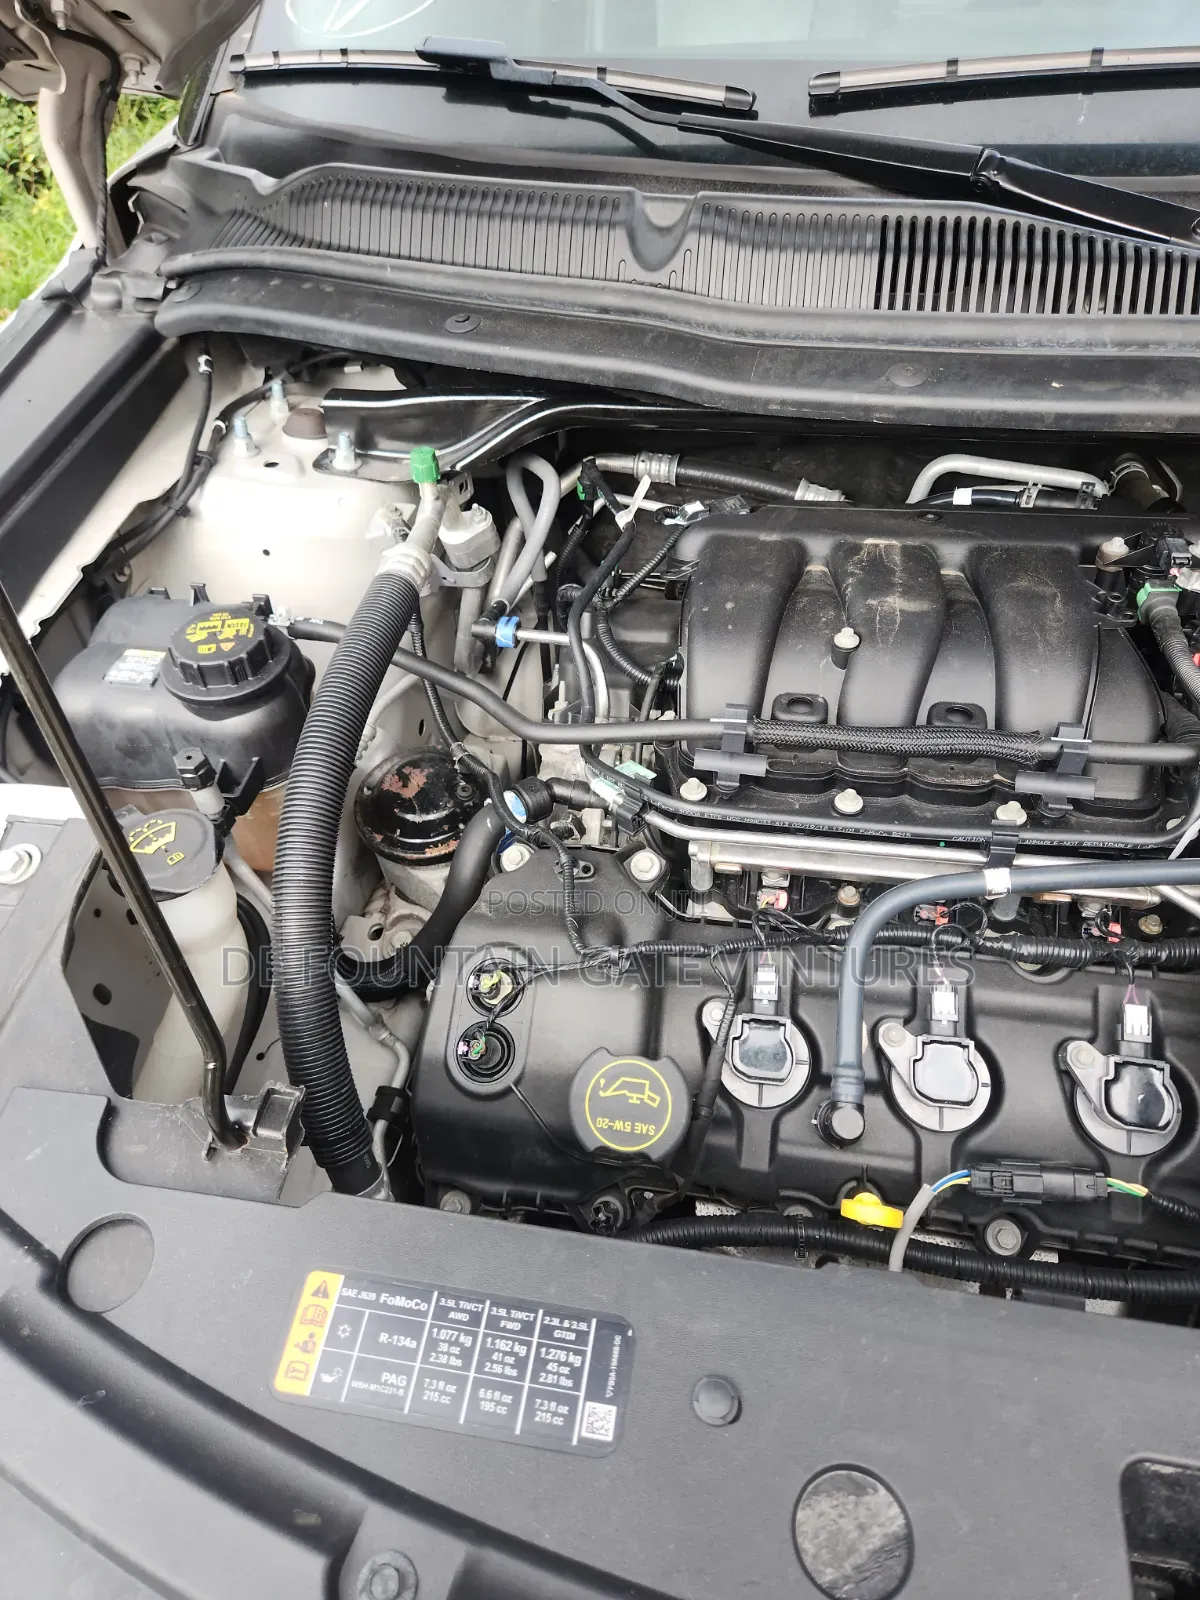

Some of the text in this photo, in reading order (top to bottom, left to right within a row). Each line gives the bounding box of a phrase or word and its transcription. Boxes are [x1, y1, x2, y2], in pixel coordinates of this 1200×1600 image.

[596, 1117, 656, 1135] SAE 5W-20
[341, 1288, 358, 1298] SAE
[379, 1293, 428, 1311] FoMoCo
[439, 1298, 457, 1308] 3.5L
[448, 1311, 470, 1321] AWD
[490, 1307, 508, 1317] 3.5L
[500, 1320, 521, 1331] FWD
[543, 1316, 562, 1326] 2.3L
[571, 1321, 589, 1331] 3.5L
[378, 1332, 418, 1349] R-134a
[431, 1327, 473, 1347] 1.077 kg
[437, 1342, 461, 1355] 38 oz
[485, 1337, 528, 1357] 1.162 kg
[430, 1352, 463, 1367] 2.38 lbs
[492, 1352, 515, 1364] 41 oz
[539, 1347, 583, 1367] 1.276 kg
[484, 1362, 518, 1377] 2.56 lbs
[546, 1362, 570, 1375] 45 oz
[381, 1371, 408, 1387] PAG
[423, 1378, 436, 1389] 7.3
[445, 1384, 457, 1393] oz
[539, 1373, 573, 1388] 2.81 lbs
[423, 1391, 451, 1404] 215 cc
[501, 1394, 513, 1403] oz
[480, 1400, 508, 1415] 195 cc
[534, 1398, 548, 1410] 7.3
[556, 1405, 569, 1415] oz
[534, 1411, 564, 1426] 215 cc
